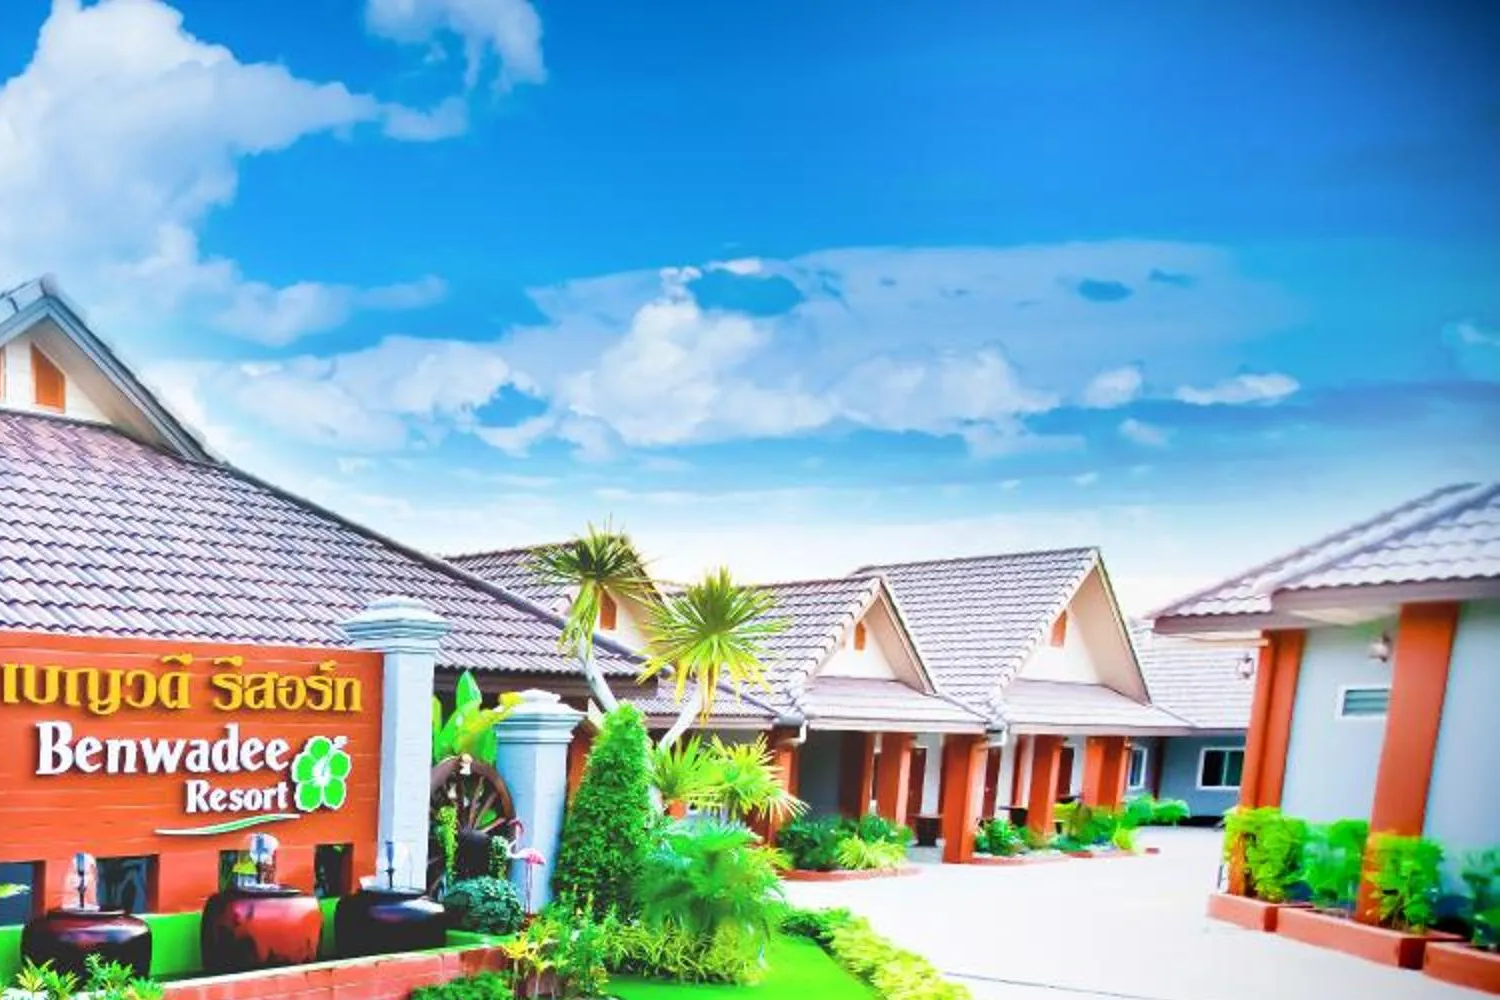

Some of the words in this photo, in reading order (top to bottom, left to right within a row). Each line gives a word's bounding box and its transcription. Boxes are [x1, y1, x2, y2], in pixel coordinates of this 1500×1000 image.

[211, 655, 363, 713] รีสอร์ท
[36, 721, 289, 775] Benwadee
[185, 780, 288, 813] Resort
